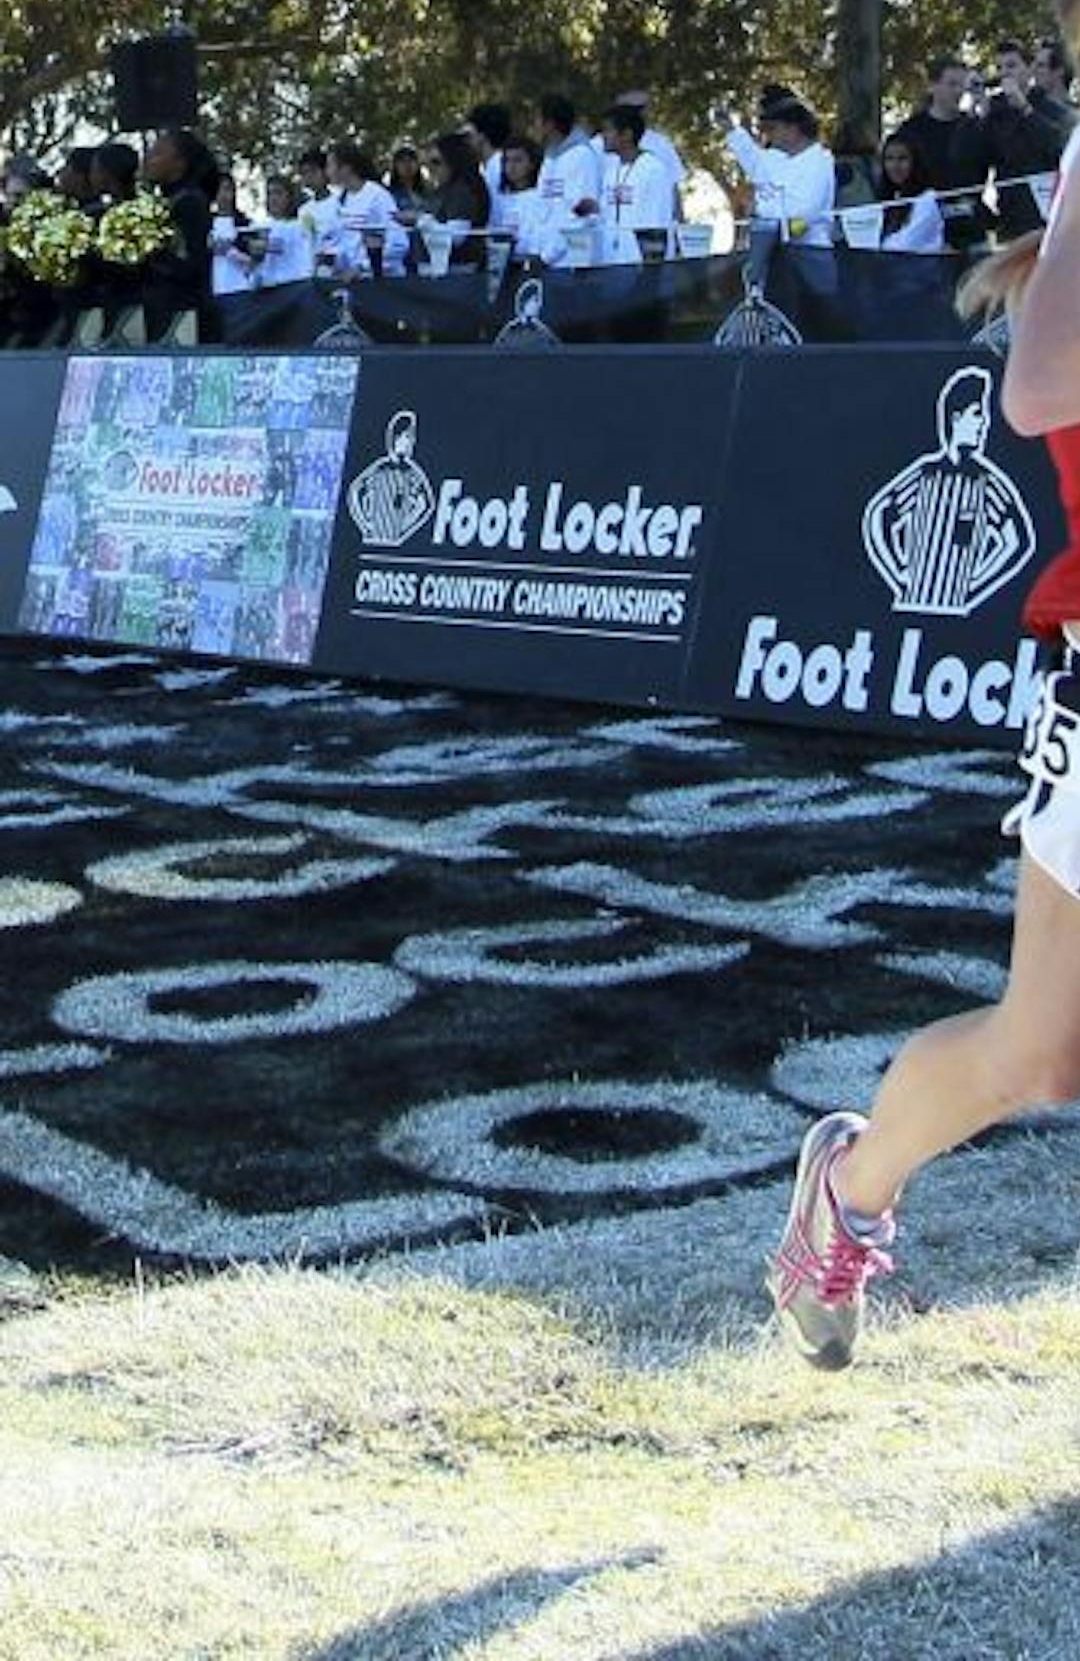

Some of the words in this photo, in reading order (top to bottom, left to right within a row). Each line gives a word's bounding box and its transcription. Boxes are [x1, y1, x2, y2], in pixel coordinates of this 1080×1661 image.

[433, 478, 530, 550] Foot
[540, 482, 703, 559] Locker
[354, 569, 418, 606] CROSS
[419, 574, 512, 613] COUNTRY
[512, 581, 687, 626] CHAMPIONSHIPS
[735, 617, 874, 711] Foot
[892, 629, 1046, 731] Lock
